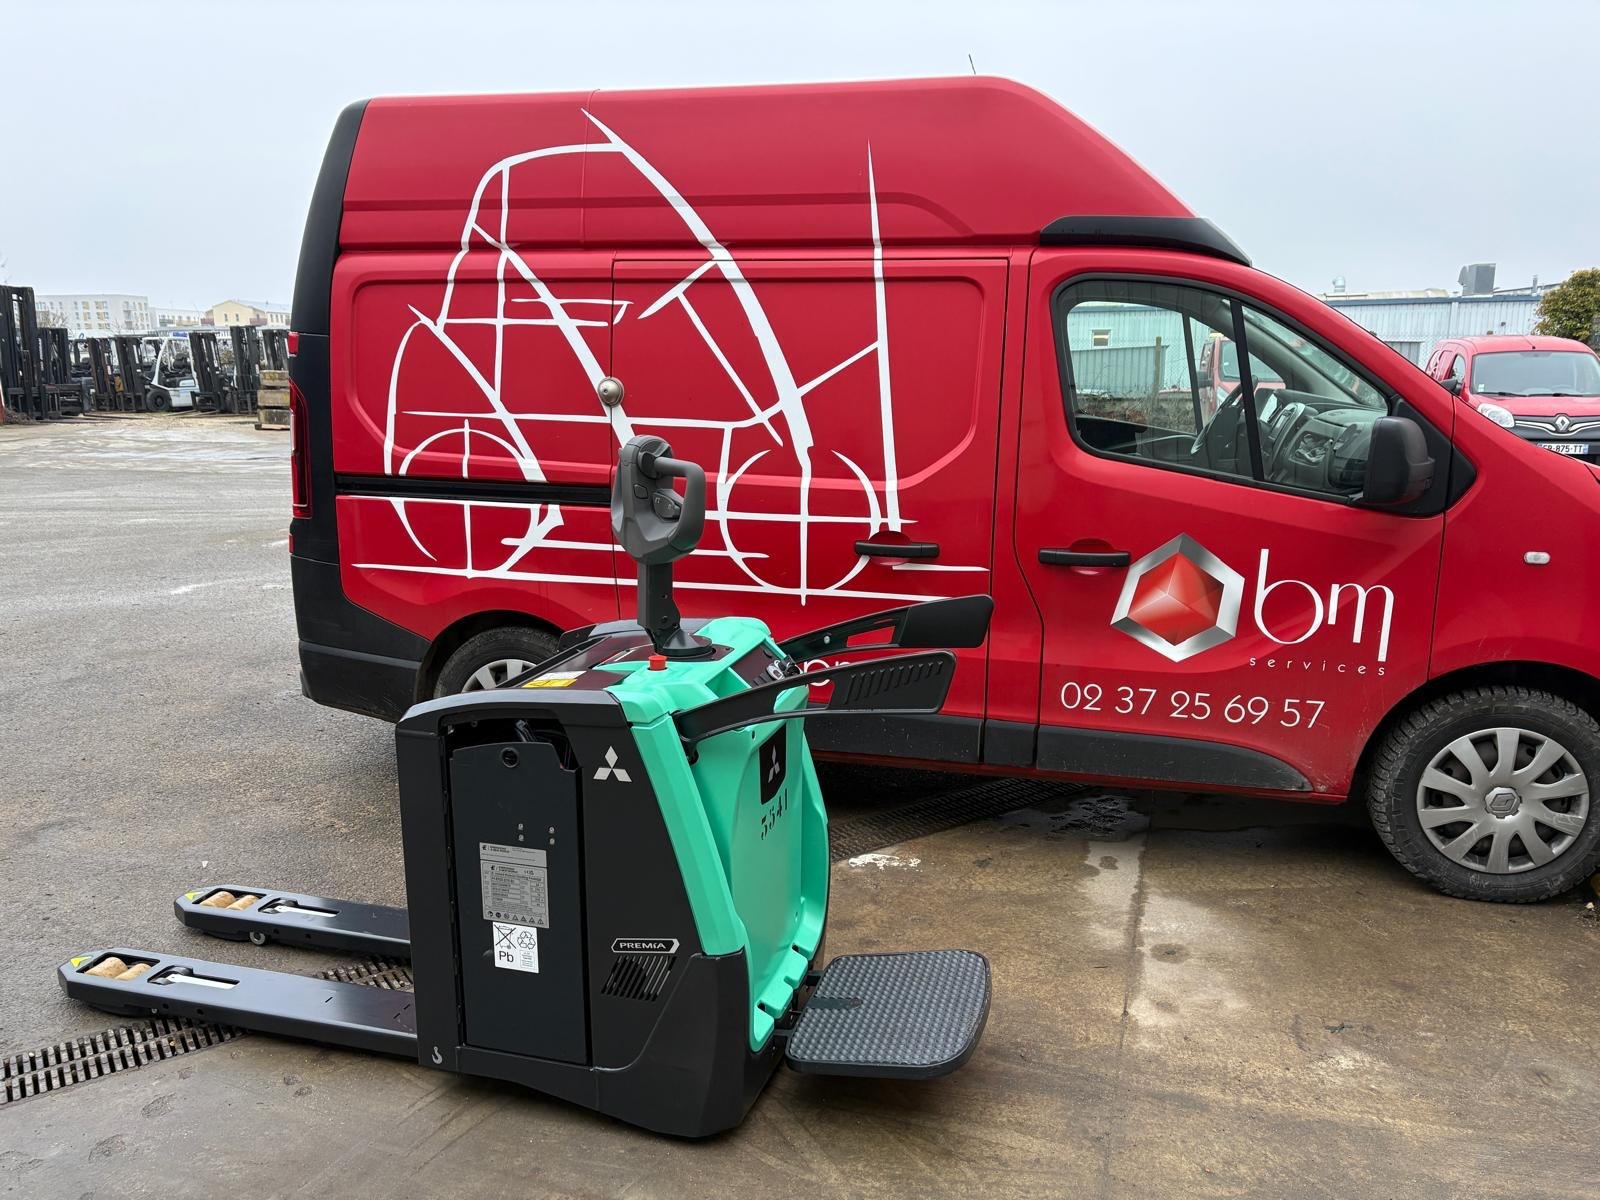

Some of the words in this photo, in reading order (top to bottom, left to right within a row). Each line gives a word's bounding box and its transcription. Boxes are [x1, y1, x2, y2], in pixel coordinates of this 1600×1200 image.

[1254, 548, 1395, 662] bm
[1249, 656, 1386, 677] services
[1060, 681, 1102, 711] 02
[1114, 686, 1157, 715] 37
[1169, 690, 1211, 720] 25
[1223, 694, 1269, 725] 69
[1279, 700, 1326, 729] 57
[498, 950, 515, 963] Pb
